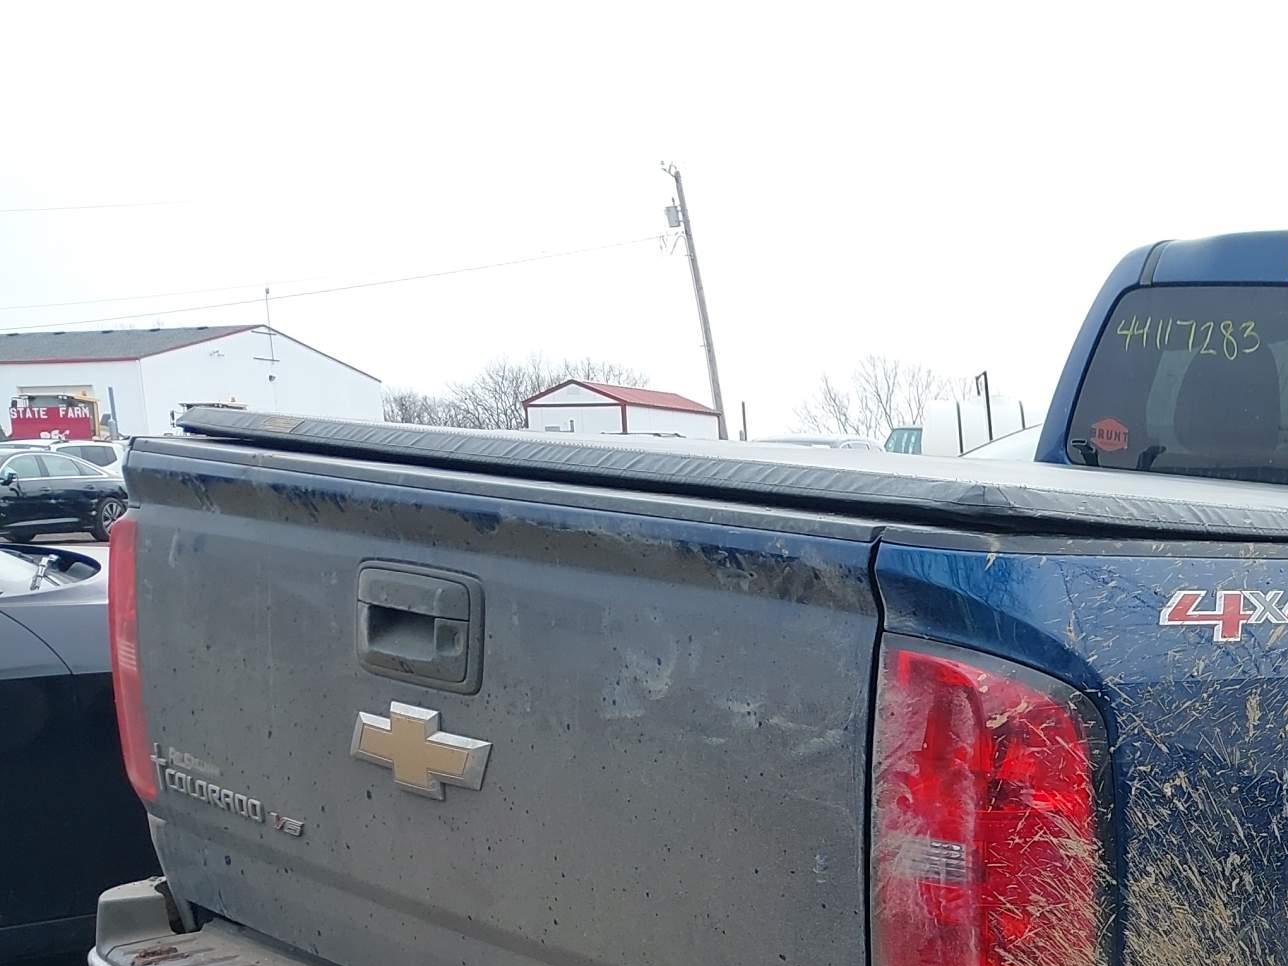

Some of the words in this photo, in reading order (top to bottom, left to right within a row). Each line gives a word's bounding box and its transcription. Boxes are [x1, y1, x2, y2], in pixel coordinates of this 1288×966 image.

[1117, 314, 1260, 360] 44117283
[9, 407, 48, 419] STATE
[165, 768, 265, 824] COLORADO
[268, 811, 305, 838] V6
